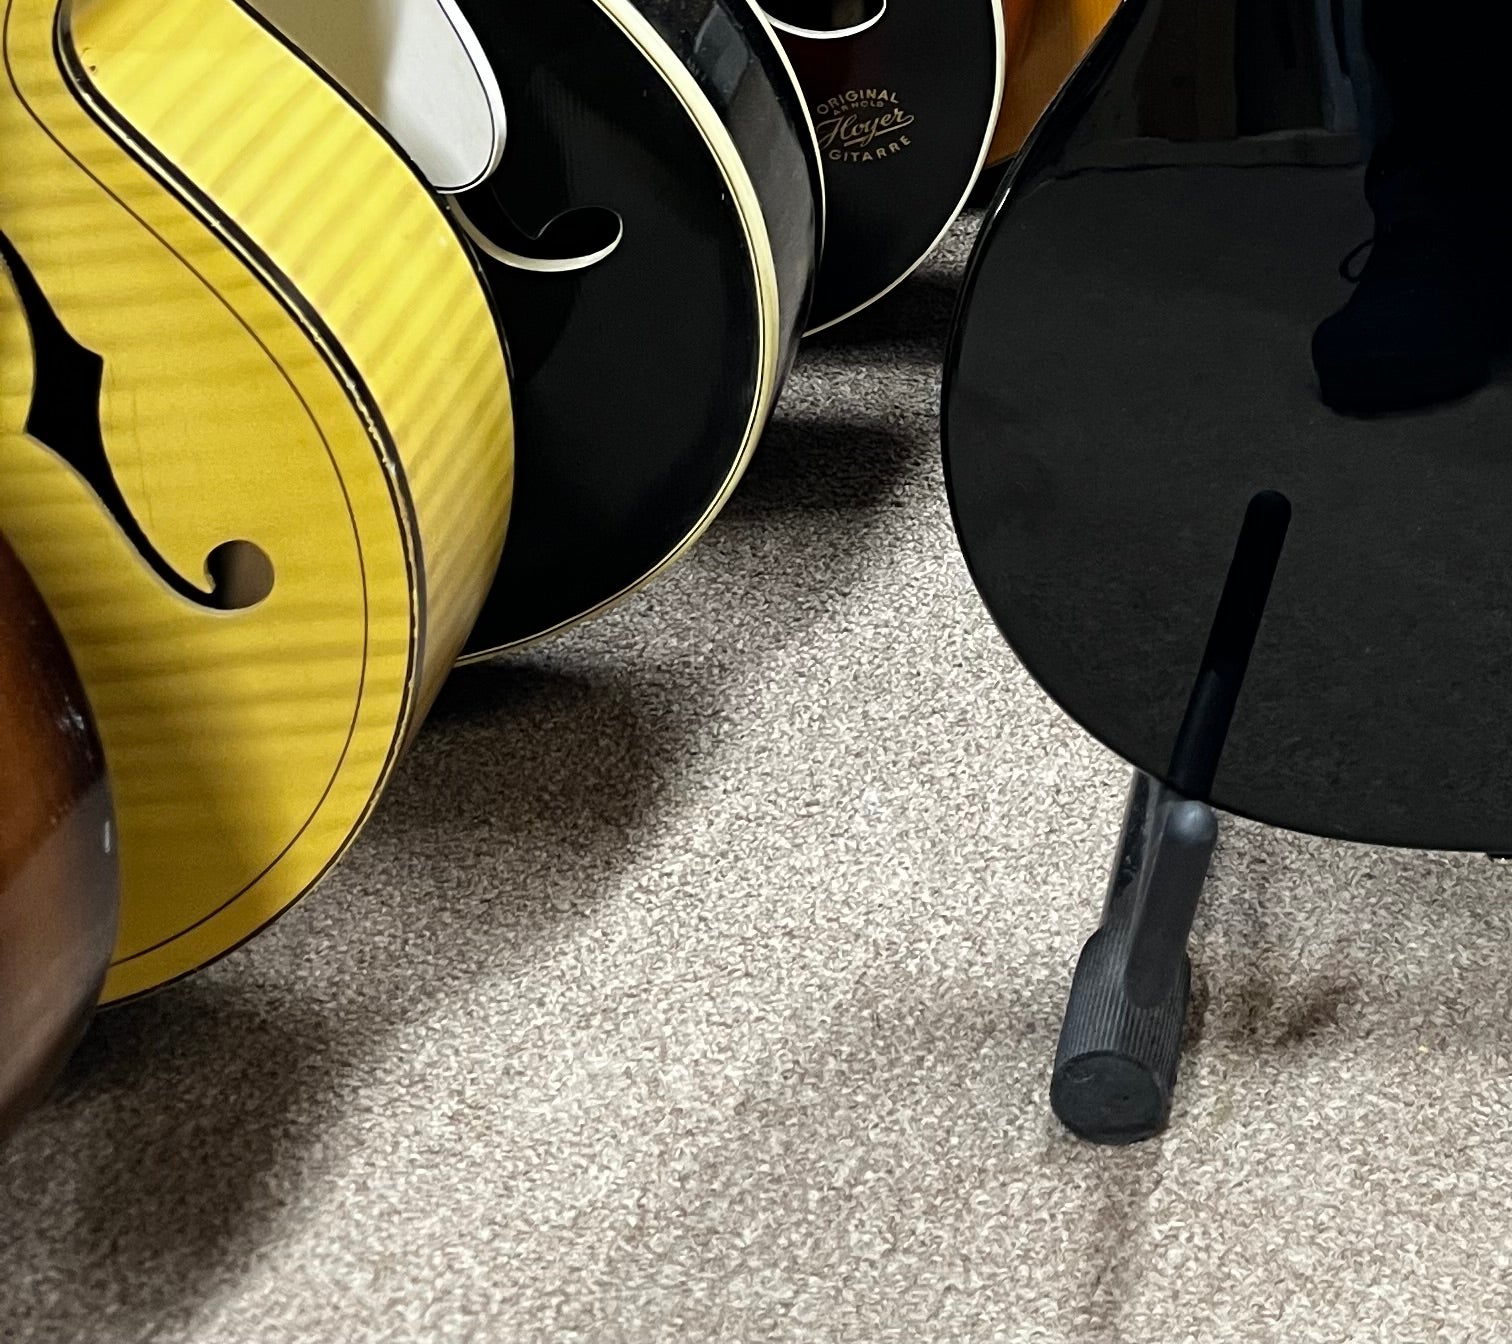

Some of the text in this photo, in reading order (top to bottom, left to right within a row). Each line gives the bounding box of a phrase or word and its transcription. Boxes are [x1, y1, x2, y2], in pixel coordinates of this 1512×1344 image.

[816, 88, 900, 115] ORIGINAL
[832, 99, 886, 116] ARNOLD
[815, 107, 915, 151] Hoyer
[827, 134, 913, 163] GITARRE
